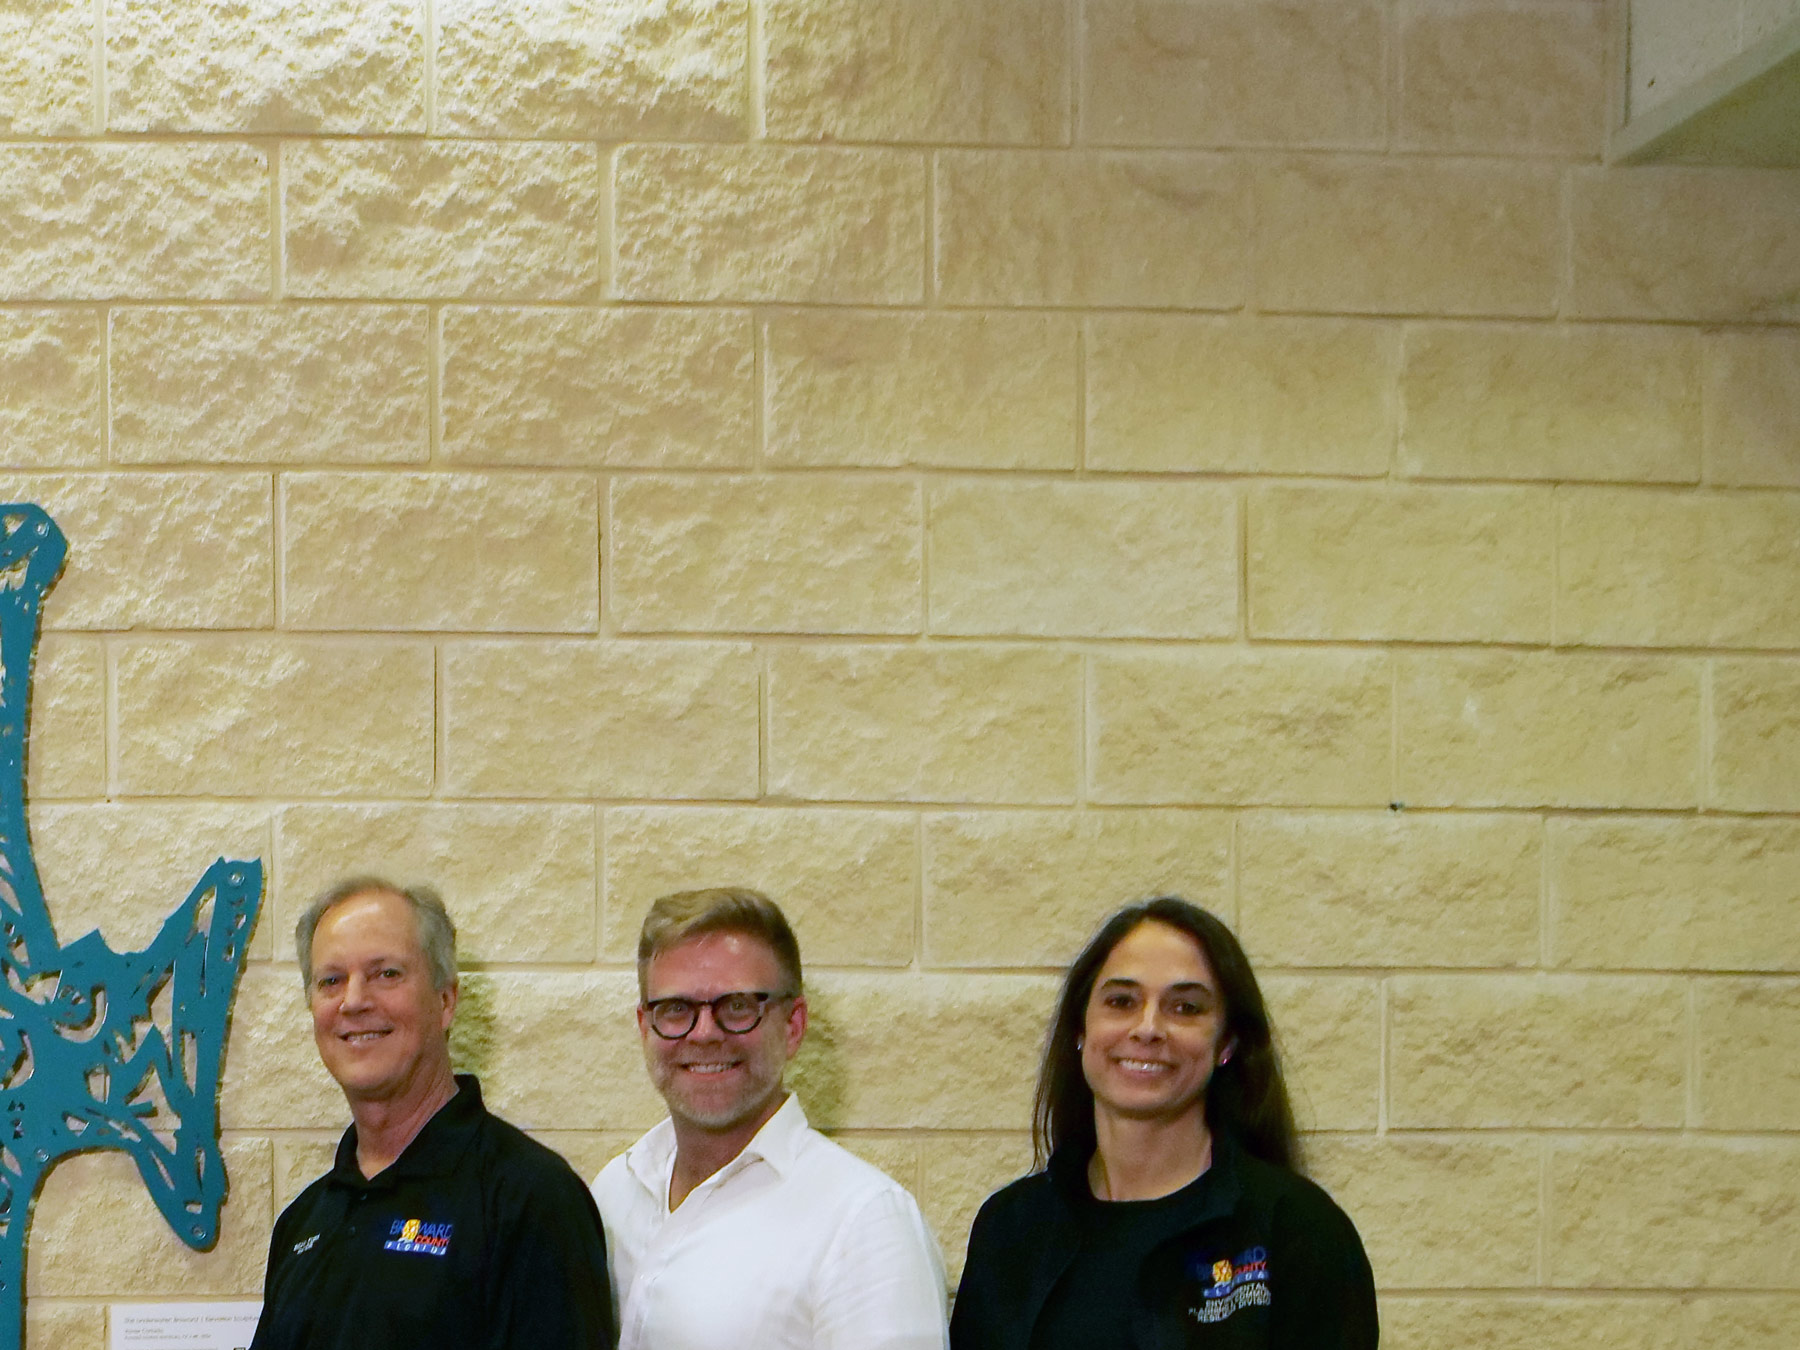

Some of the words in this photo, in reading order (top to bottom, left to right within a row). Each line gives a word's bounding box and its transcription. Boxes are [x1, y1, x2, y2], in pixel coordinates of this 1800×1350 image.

[389, 1219, 453, 1239] BRWARD
[386, 1241, 447, 1256] FLORIDA
[1203, 1270, 1265, 1298] FLOIDA
